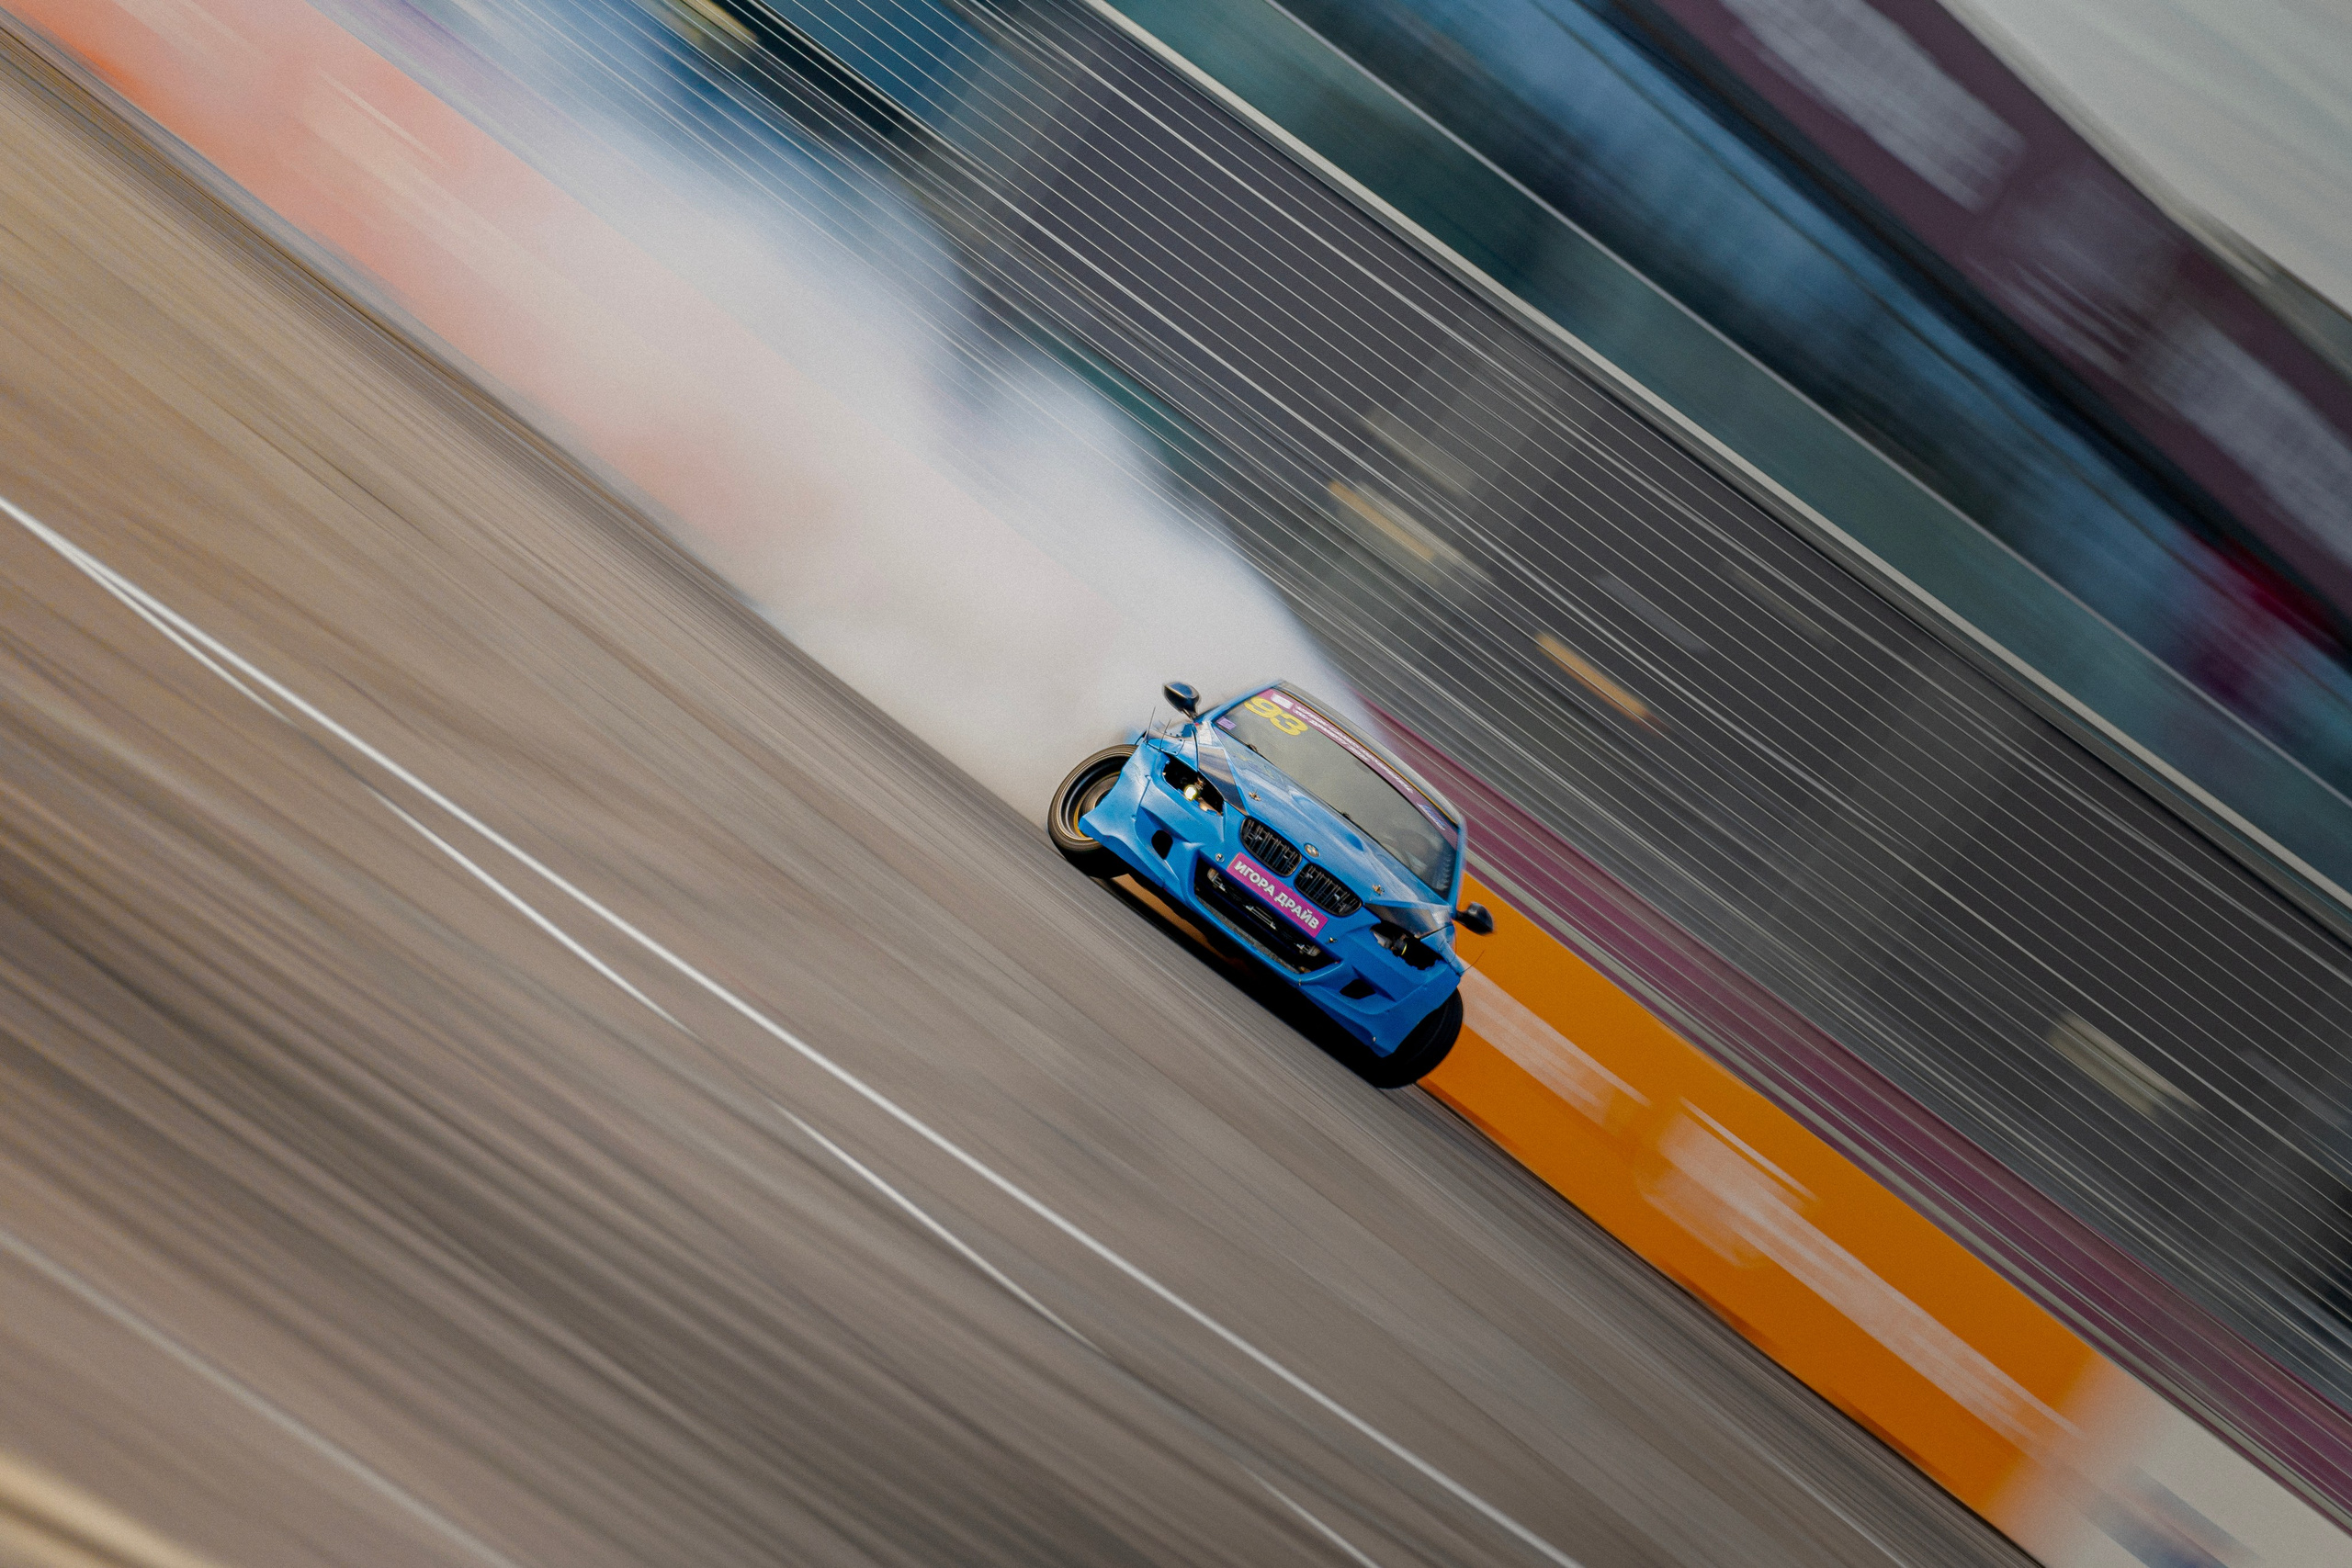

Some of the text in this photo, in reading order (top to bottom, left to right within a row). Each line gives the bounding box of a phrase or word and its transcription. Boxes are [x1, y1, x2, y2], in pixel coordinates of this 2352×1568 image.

[1244, 696, 1308, 736] 93
[1234, 861, 1319, 929] ИГОРА ДРАЙВ
